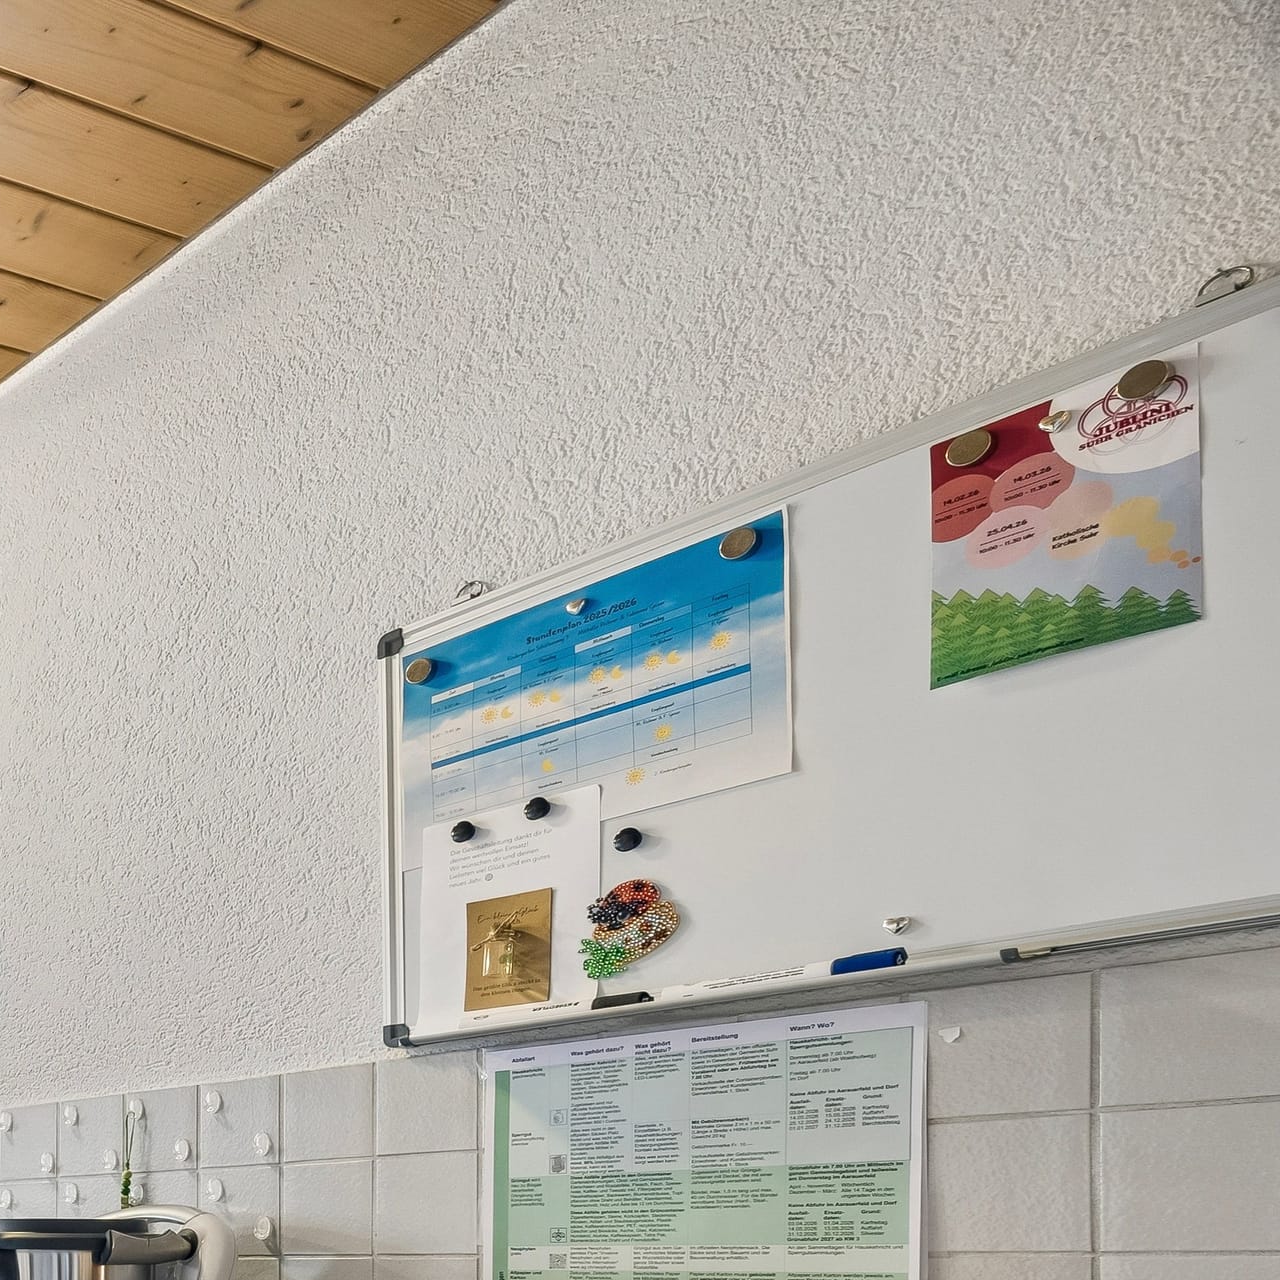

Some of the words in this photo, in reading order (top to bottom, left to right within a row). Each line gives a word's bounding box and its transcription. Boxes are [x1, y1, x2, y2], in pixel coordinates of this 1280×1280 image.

[1094, 403, 1171, 437] JUBLINI
[1078, 434, 1113, 451] SUHR
[1014, 466, 1052, 483] 14.03.26
[944, 489, 979, 506] 14.02.26
[987, 519, 1027, 537] 25.04.26
[1052, 523, 1099, 542] Katholische
[1052, 538, 1077, 549] Kirche
[1080, 531, 1099, 541] Suhr
[526, 621, 582, 644] Stundenplan
[583, 598, 637, 623] 2025/2026
[790, 1024, 815, 1032] Wann?
[692, 1034, 738, 1043] Bereitstellung
[585, 1048, 604, 1056] gehört
